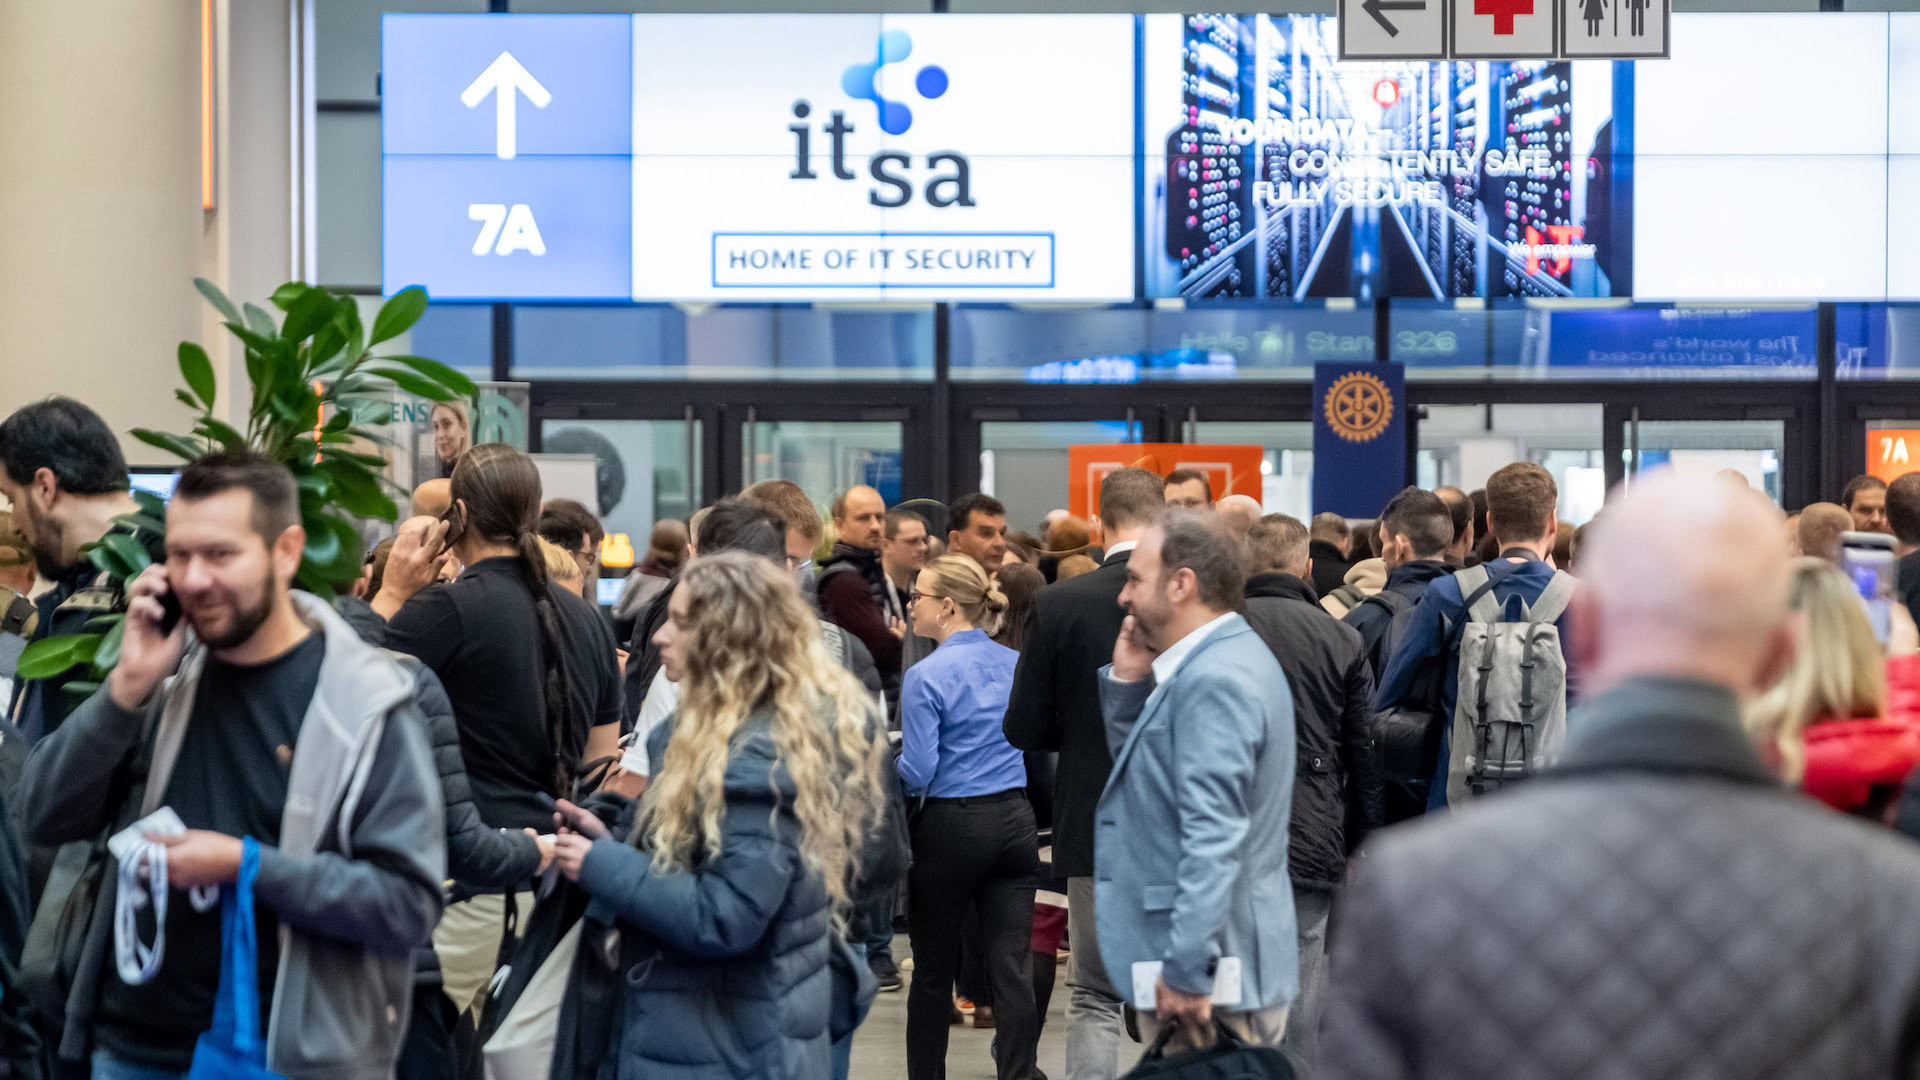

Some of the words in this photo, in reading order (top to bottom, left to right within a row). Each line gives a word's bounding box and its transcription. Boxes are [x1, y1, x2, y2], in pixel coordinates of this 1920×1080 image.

[1219, 117, 1294, 146] YOUR
[1252, 181, 1330, 207] FULLY
[1334, 181, 1444, 207] SECURE
[468, 203, 547, 256] 7A
[729, 249, 813, 269] HOME
[823, 249, 859, 269] OF
[869, 249, 895, 269] IT
[906, 249, 1036, 269] SECURITY
[1533, 243, 1597, 262] empower
[1396, 330, 1458, 353] 326
[1880, 437, 1909, 465] 7A
